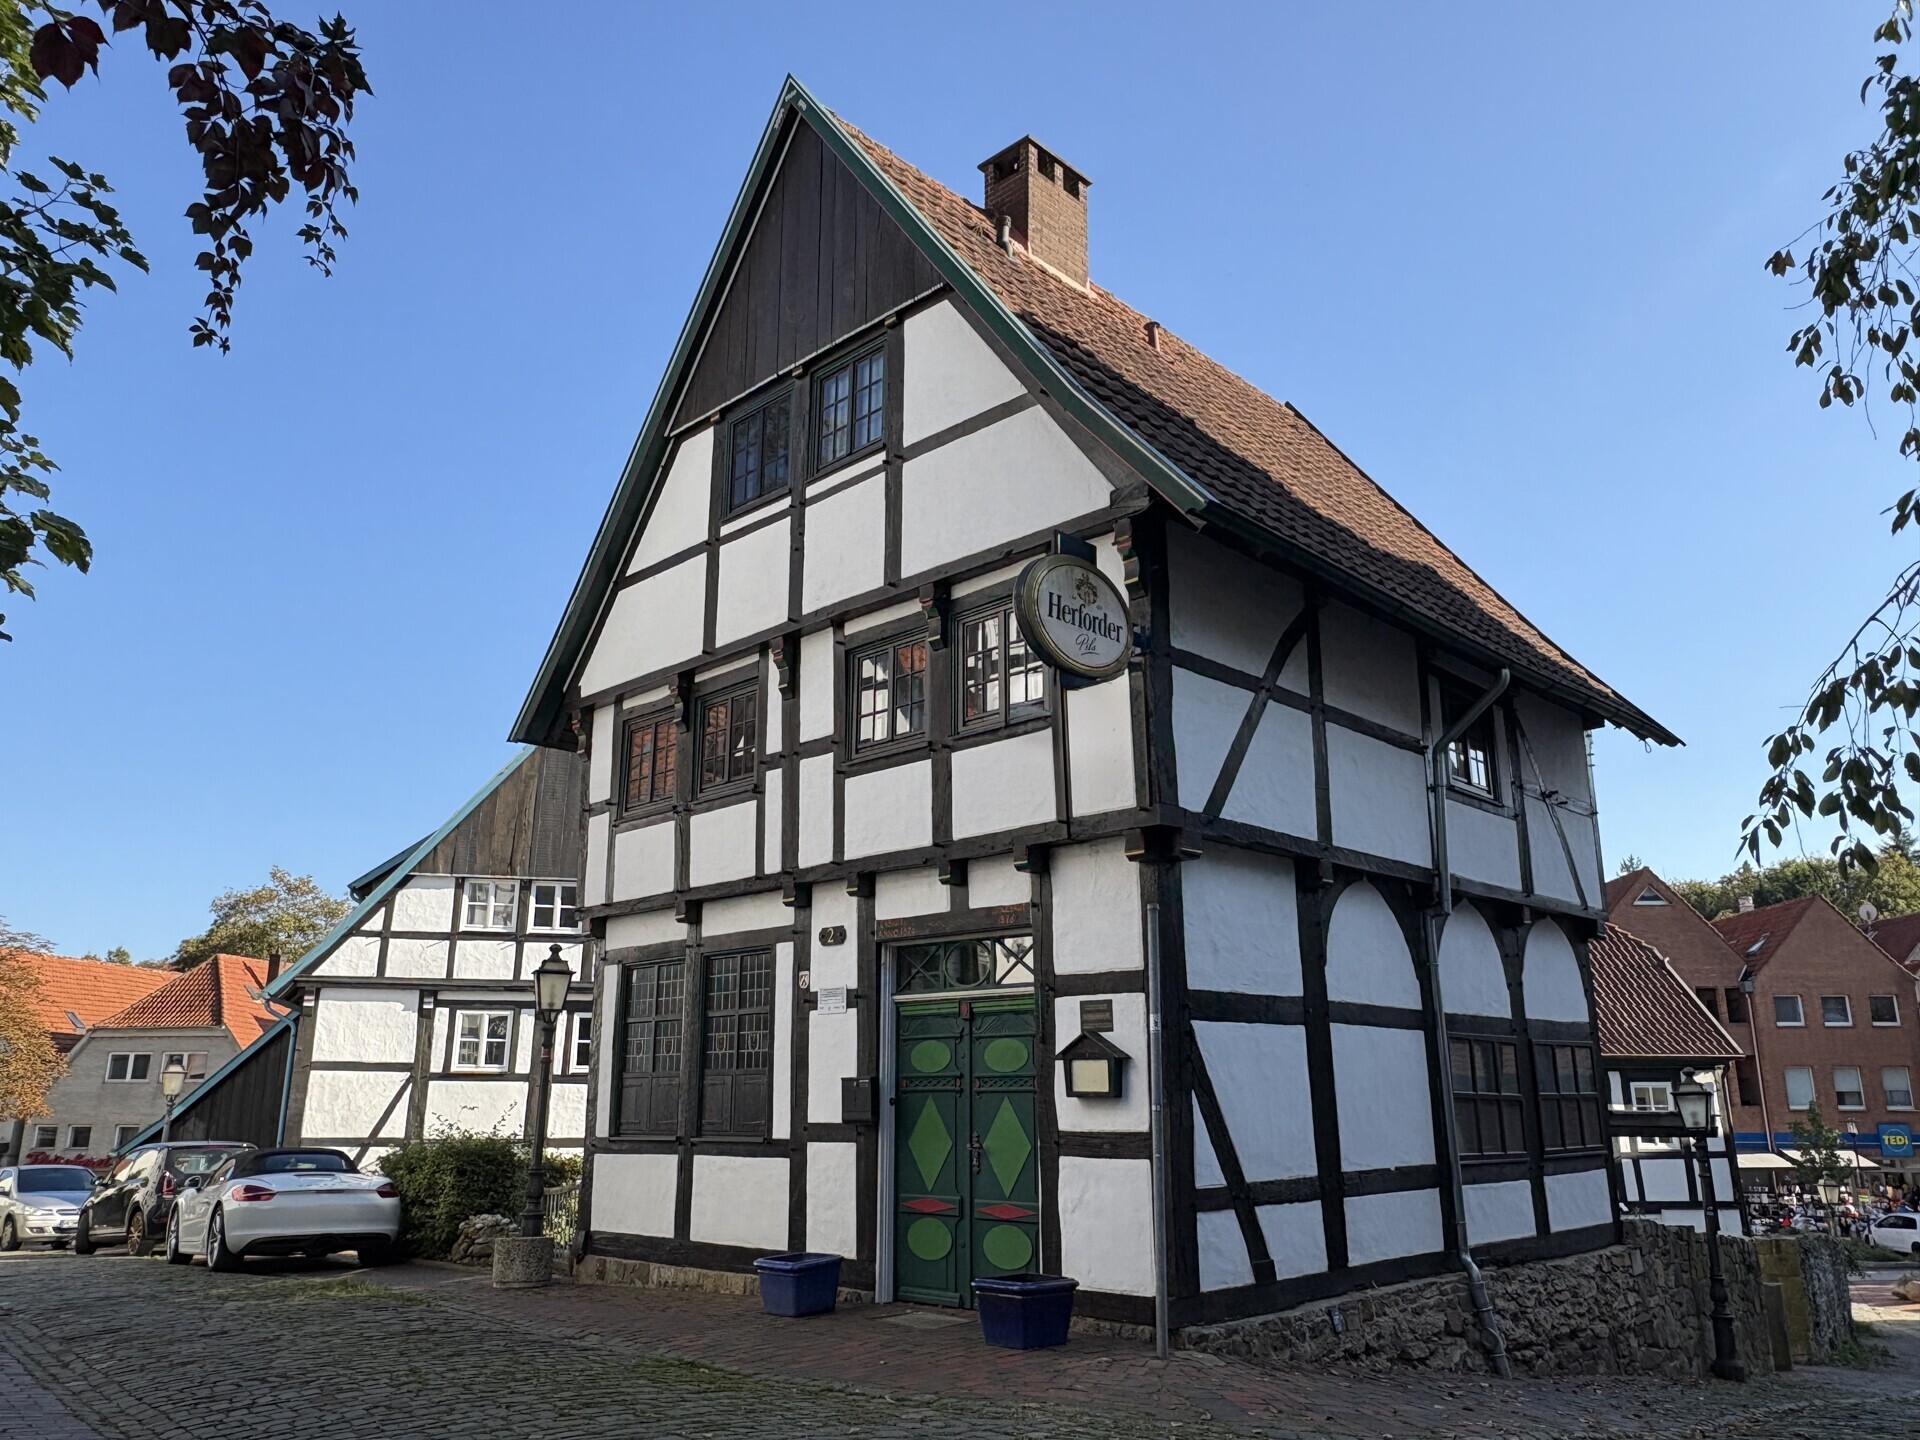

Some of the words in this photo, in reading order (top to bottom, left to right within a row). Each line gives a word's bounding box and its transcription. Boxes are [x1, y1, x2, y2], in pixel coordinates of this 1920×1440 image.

[1047, 591, 1124, 643] Herforder
[1075, 633, 1097, 652] Pils
[826, 928, 835, 944] 2
